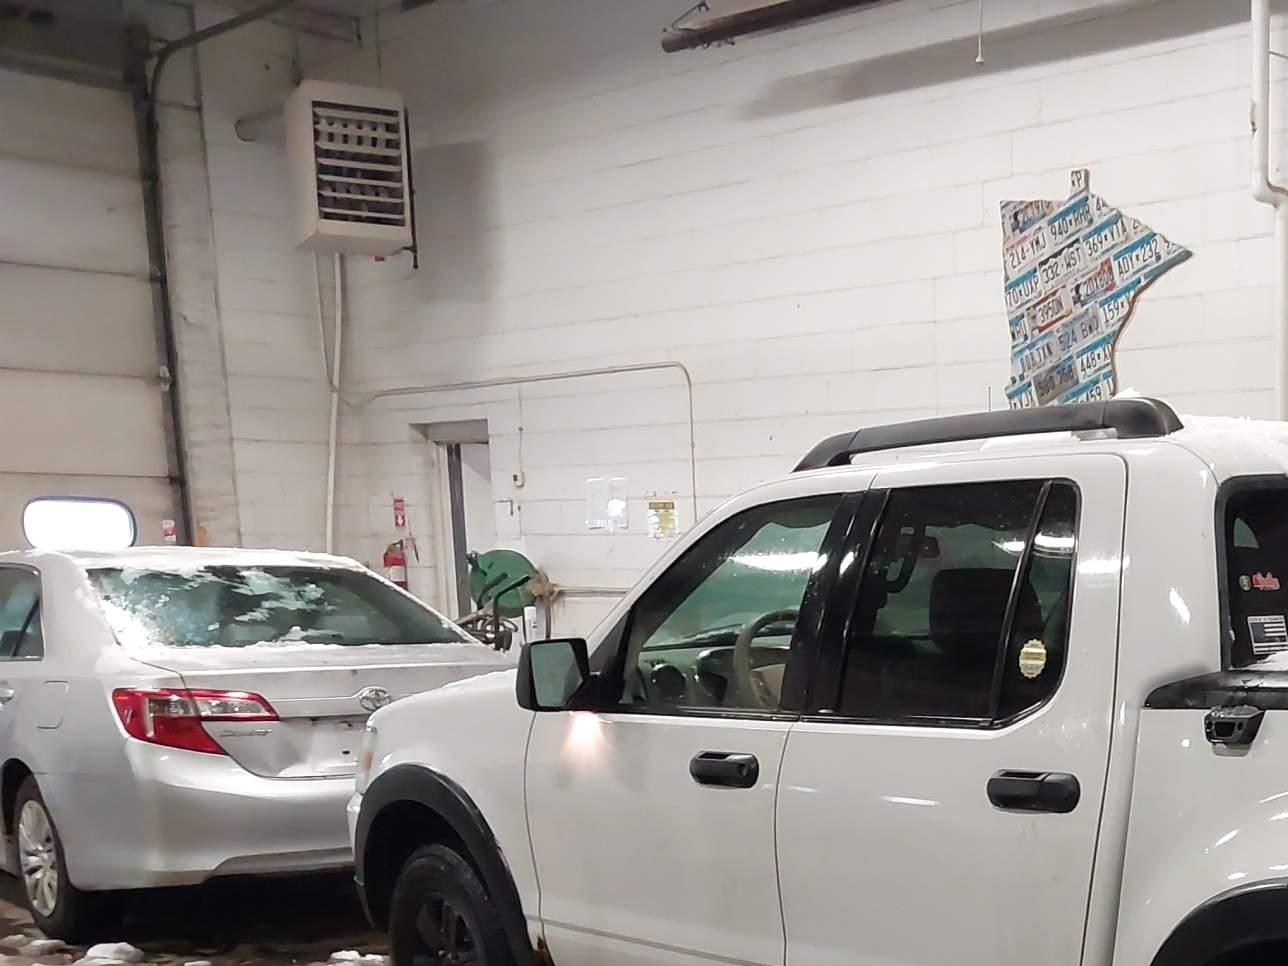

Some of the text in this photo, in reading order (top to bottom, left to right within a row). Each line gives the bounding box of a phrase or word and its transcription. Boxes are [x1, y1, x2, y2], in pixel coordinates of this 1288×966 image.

[1050, 217, 1068, 241] 940
[1086, 234, 1103, 257] 369
[1117, 238, 1161, 276] ADY 232
[1042, 262, 1060, 284] 332
[1058, 327, 1077, 351] 524
[1081, 352, 1097, 373] 448
